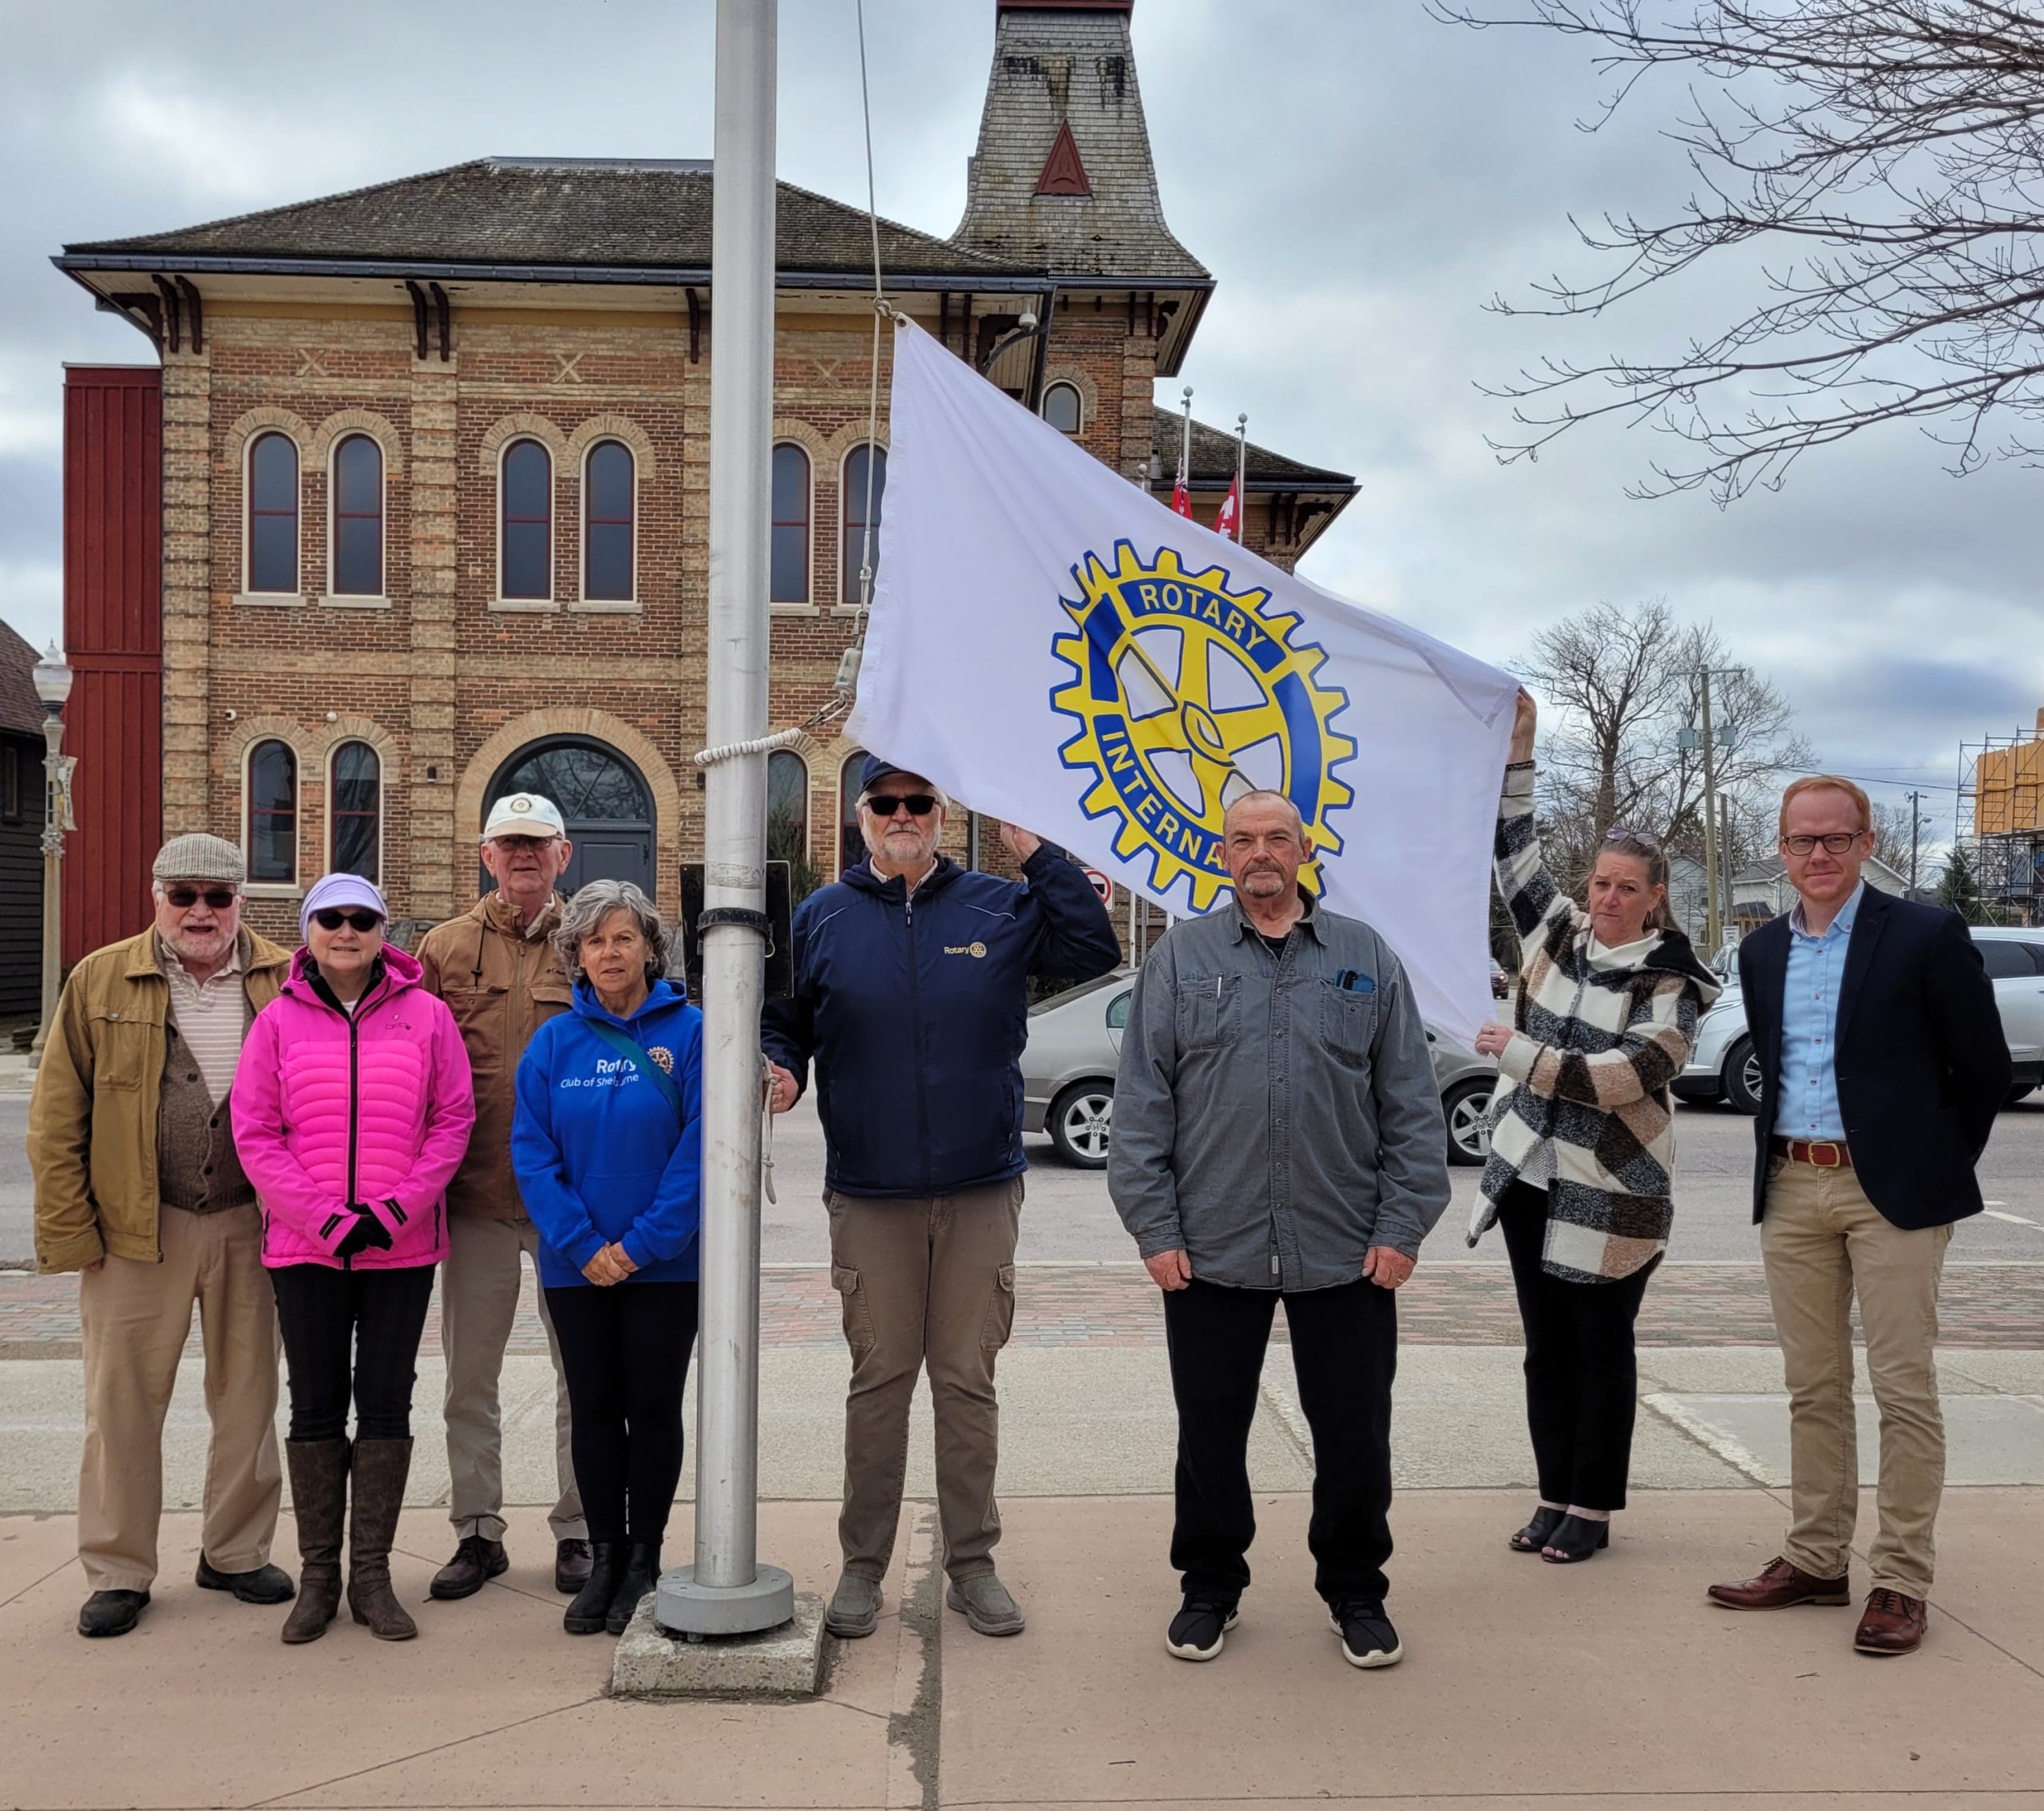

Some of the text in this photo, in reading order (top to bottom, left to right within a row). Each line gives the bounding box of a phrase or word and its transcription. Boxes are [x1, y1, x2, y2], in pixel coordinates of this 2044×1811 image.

[1139, 585, 1266, 652] ROTARY
[561, 1074, 640, 1088] Club of Shelbrne
